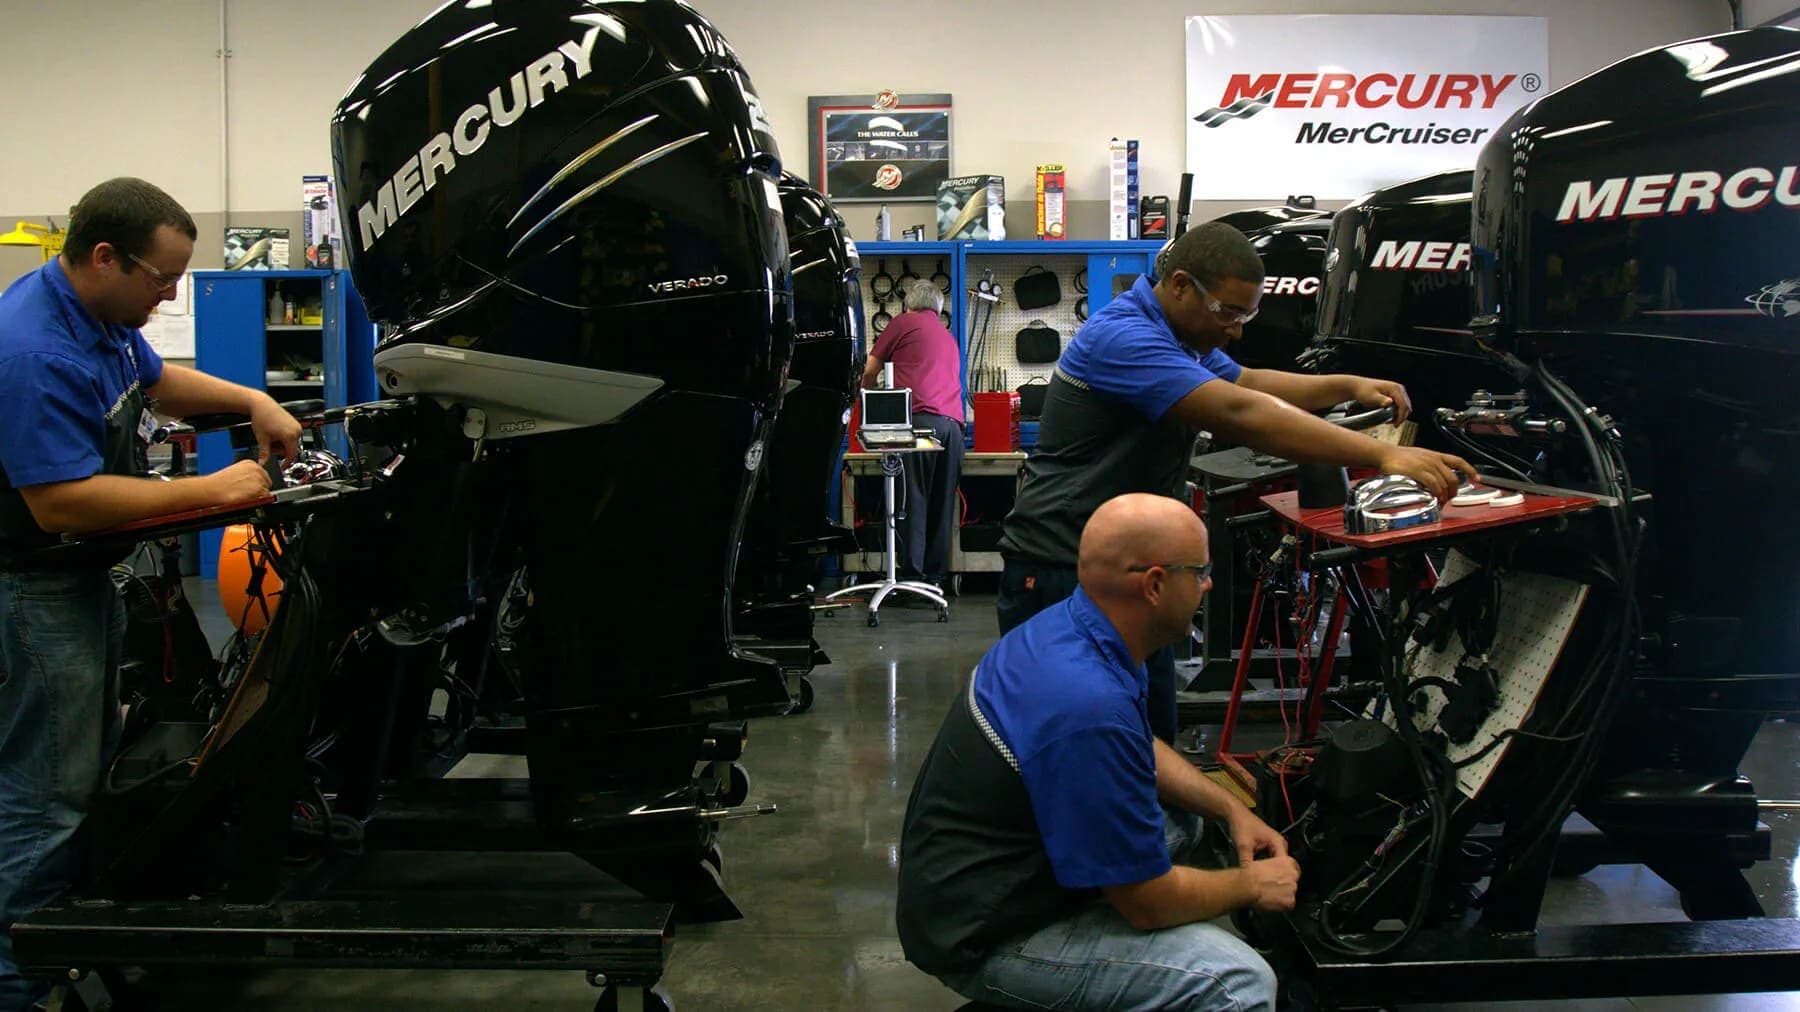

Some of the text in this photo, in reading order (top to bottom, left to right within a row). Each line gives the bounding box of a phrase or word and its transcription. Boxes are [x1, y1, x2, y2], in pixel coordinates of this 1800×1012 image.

[1219, 73, 1517, 109] MERCURY
[358, 25, 601, 252] MERCURY
[1295, 122, 1488, 145] MerCruiser
[940, 177, 980, 188] MERCURY
[647, 274, 729, 293] VERADO
